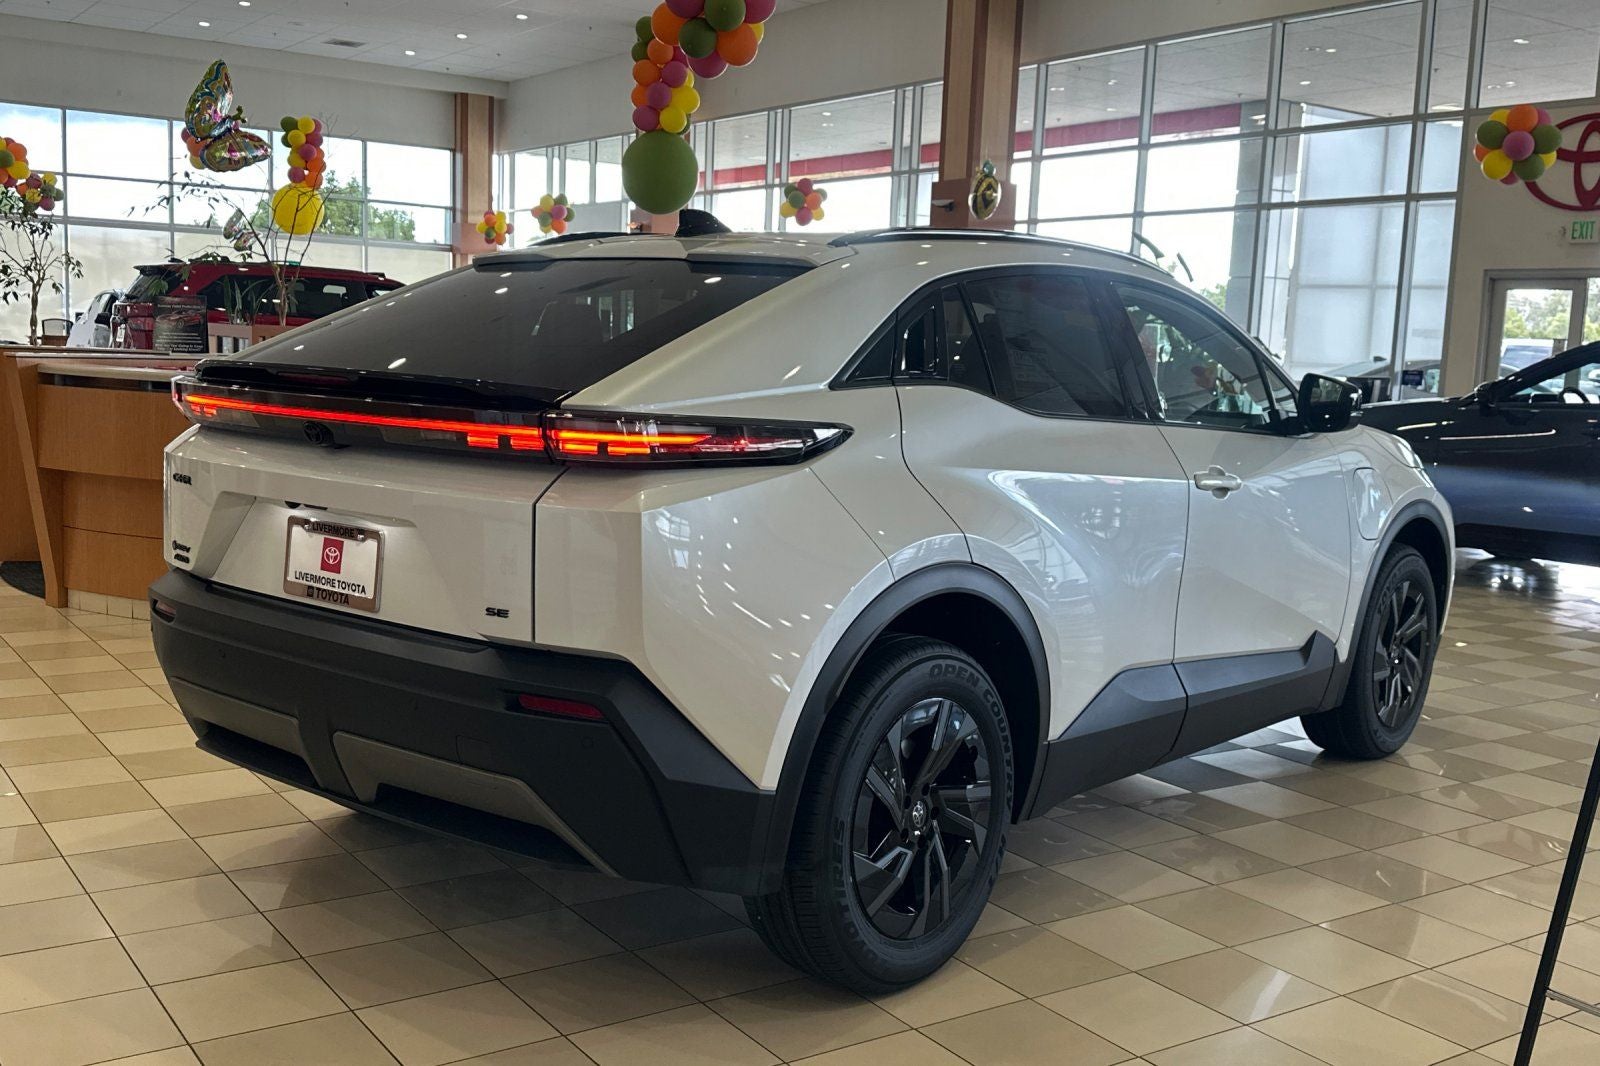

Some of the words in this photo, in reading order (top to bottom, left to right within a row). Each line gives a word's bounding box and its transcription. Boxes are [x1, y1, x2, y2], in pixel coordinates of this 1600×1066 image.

[1572, 221, 1596, 240] EXIT
[312, 522, 355, 538] LIVERMORE
[294, 570, 336, 588] LIVERMORE
[337, 580, 366, 595] TOYOTA
[316, 588, 350, 605] TOYOTA
[485, 606, 510, 619] SE
[928, 662, 981, 689] OPEN
[982, 688, 1014, 813] COUNTRY
